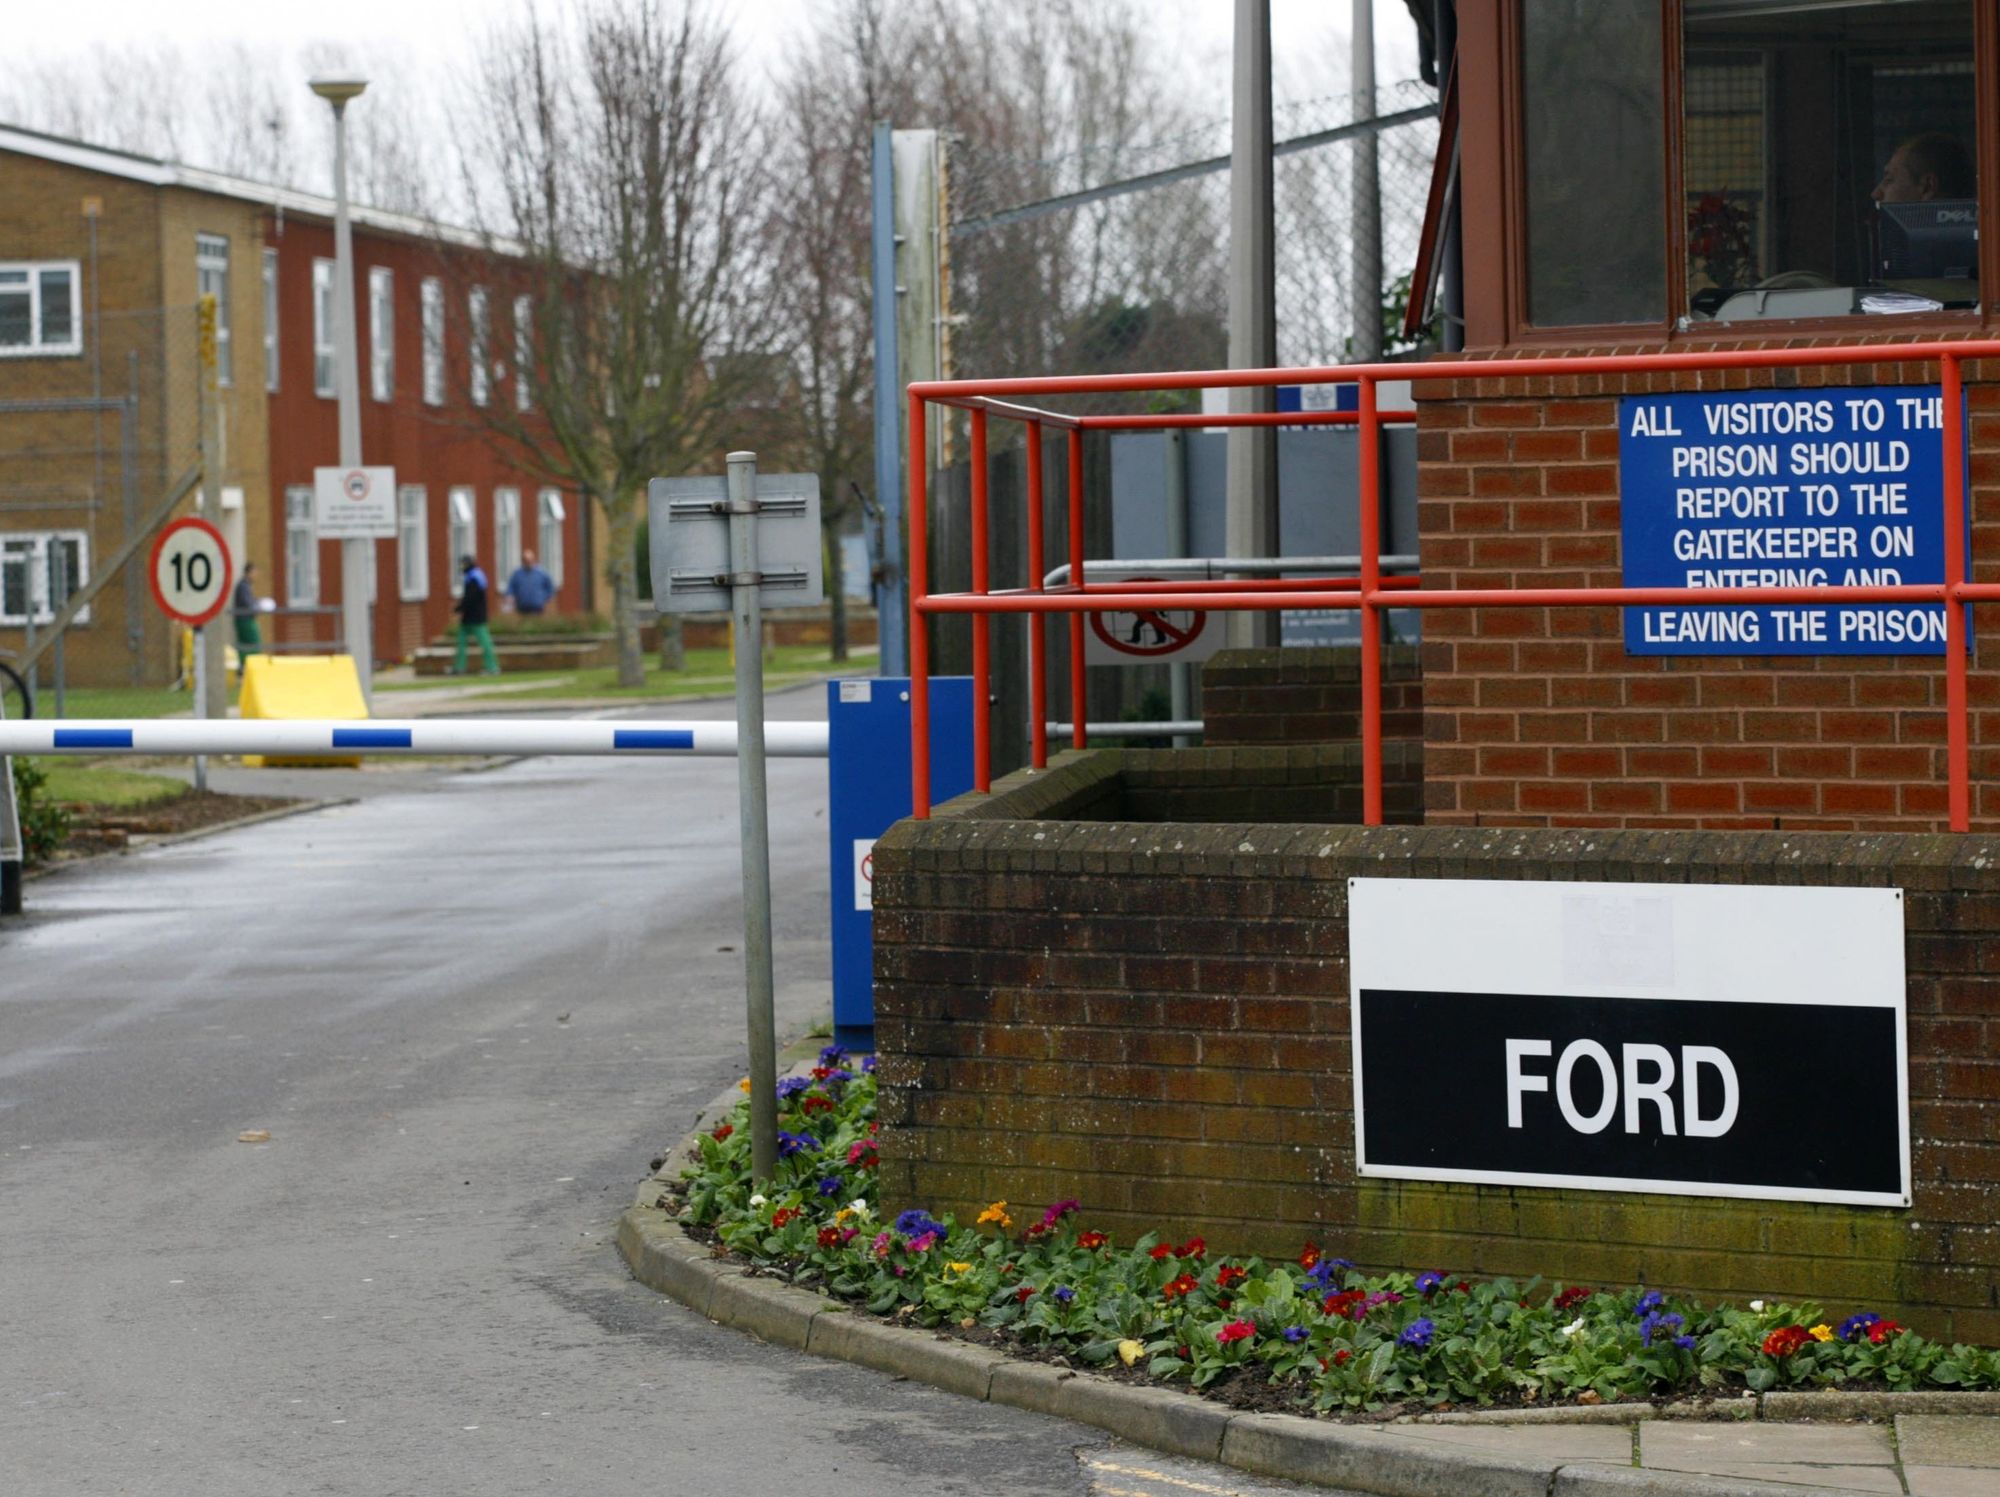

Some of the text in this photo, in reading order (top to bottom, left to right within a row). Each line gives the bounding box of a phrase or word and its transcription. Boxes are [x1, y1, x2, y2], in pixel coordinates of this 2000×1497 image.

[1631, 405, 1682, 437] ALL
[1703, 400, 1834, 435] VISITORS
[1846, 398, 1885, 431] TO
[1672, 440, 1910, 477] PRISON SHOULD
[1676, 483, 1908, 519] REPORT TO THE
[1673, 525, 1914, 561] GATEKEEPER ON
[170, 551, 212, 593] 10
[1686, 567, 1902, 589] ENTERING AND
[1644, 609, 1947, 643] LEAVING THE PRISON
[1505, 1037, 1740, 1139] FORD
